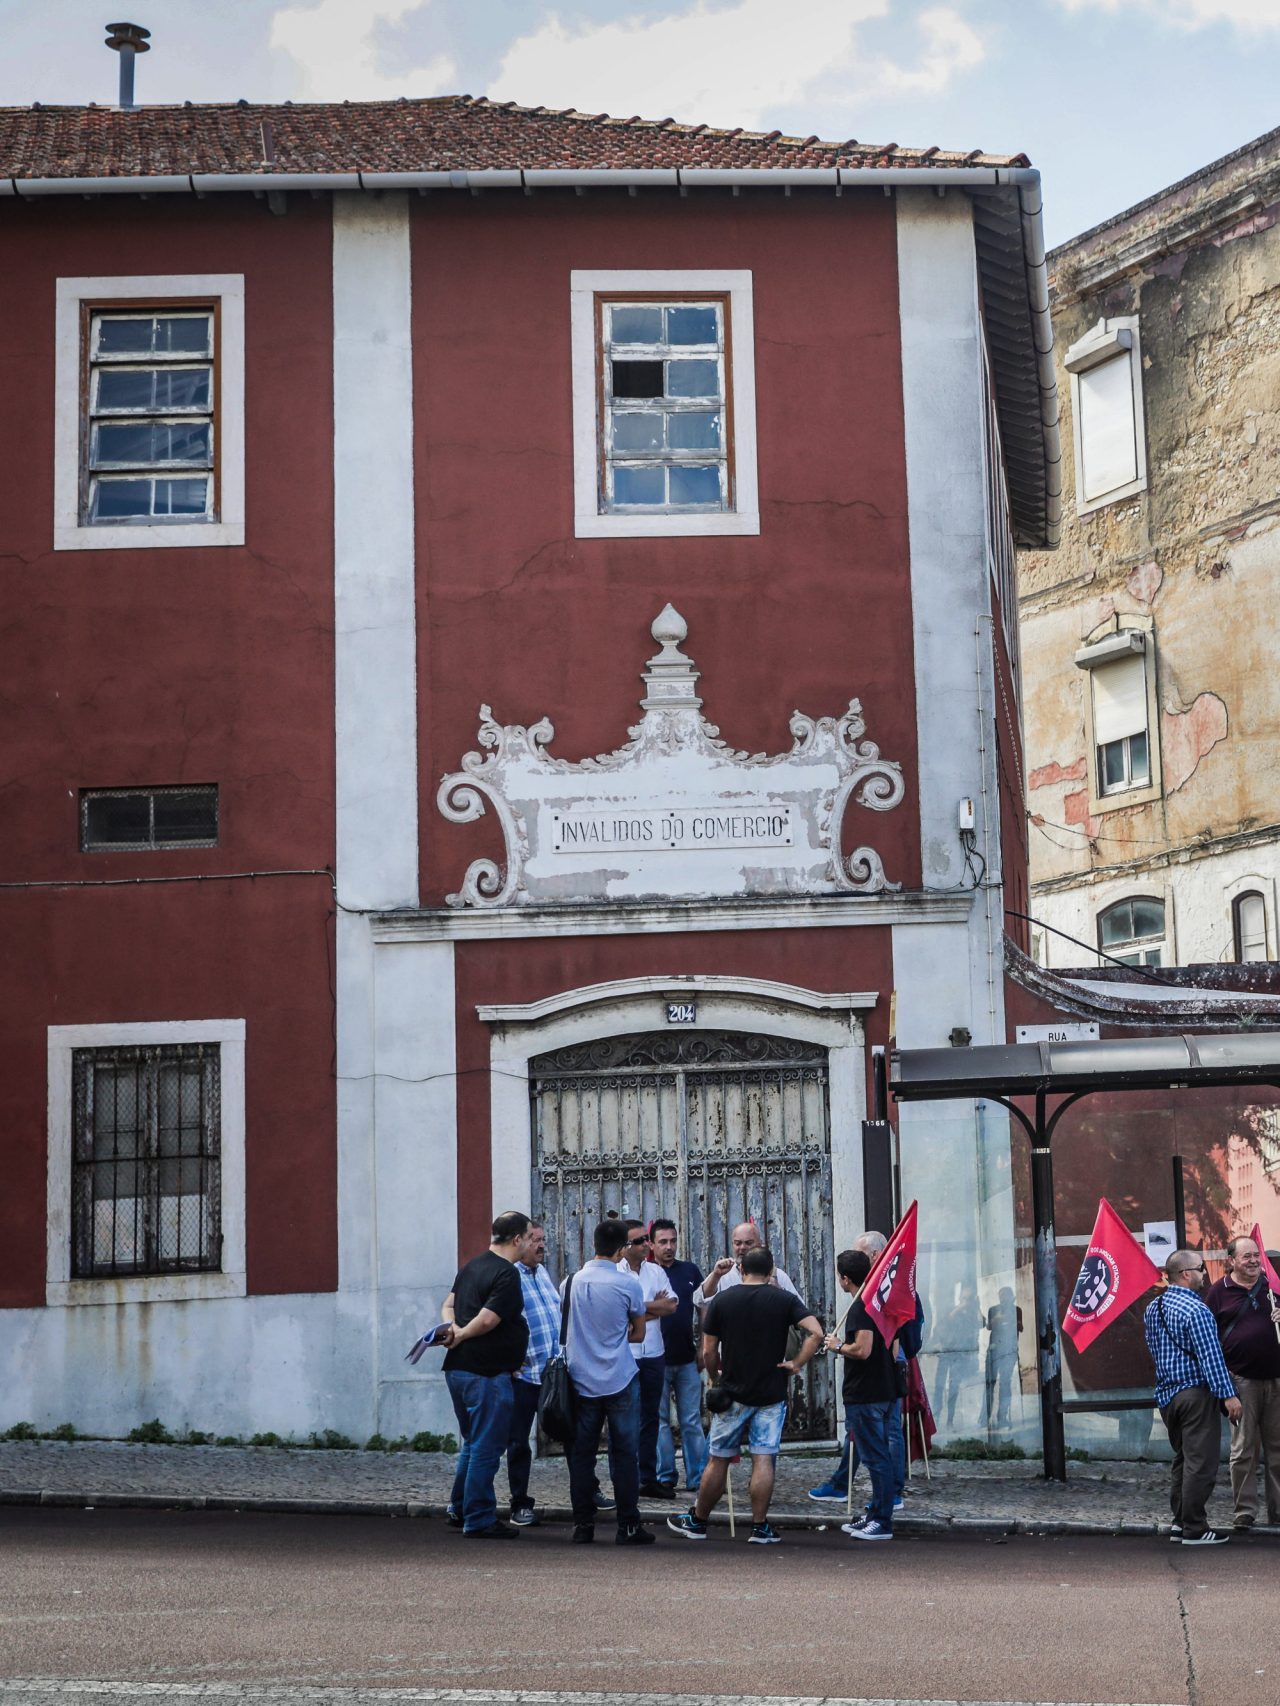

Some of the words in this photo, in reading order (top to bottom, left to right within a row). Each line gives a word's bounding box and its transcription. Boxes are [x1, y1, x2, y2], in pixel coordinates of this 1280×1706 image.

[661, 818, 684, 841] DO
[669, 1005, 694, 1022] 204
[1048, 1032, 1067, 1042] RUA
